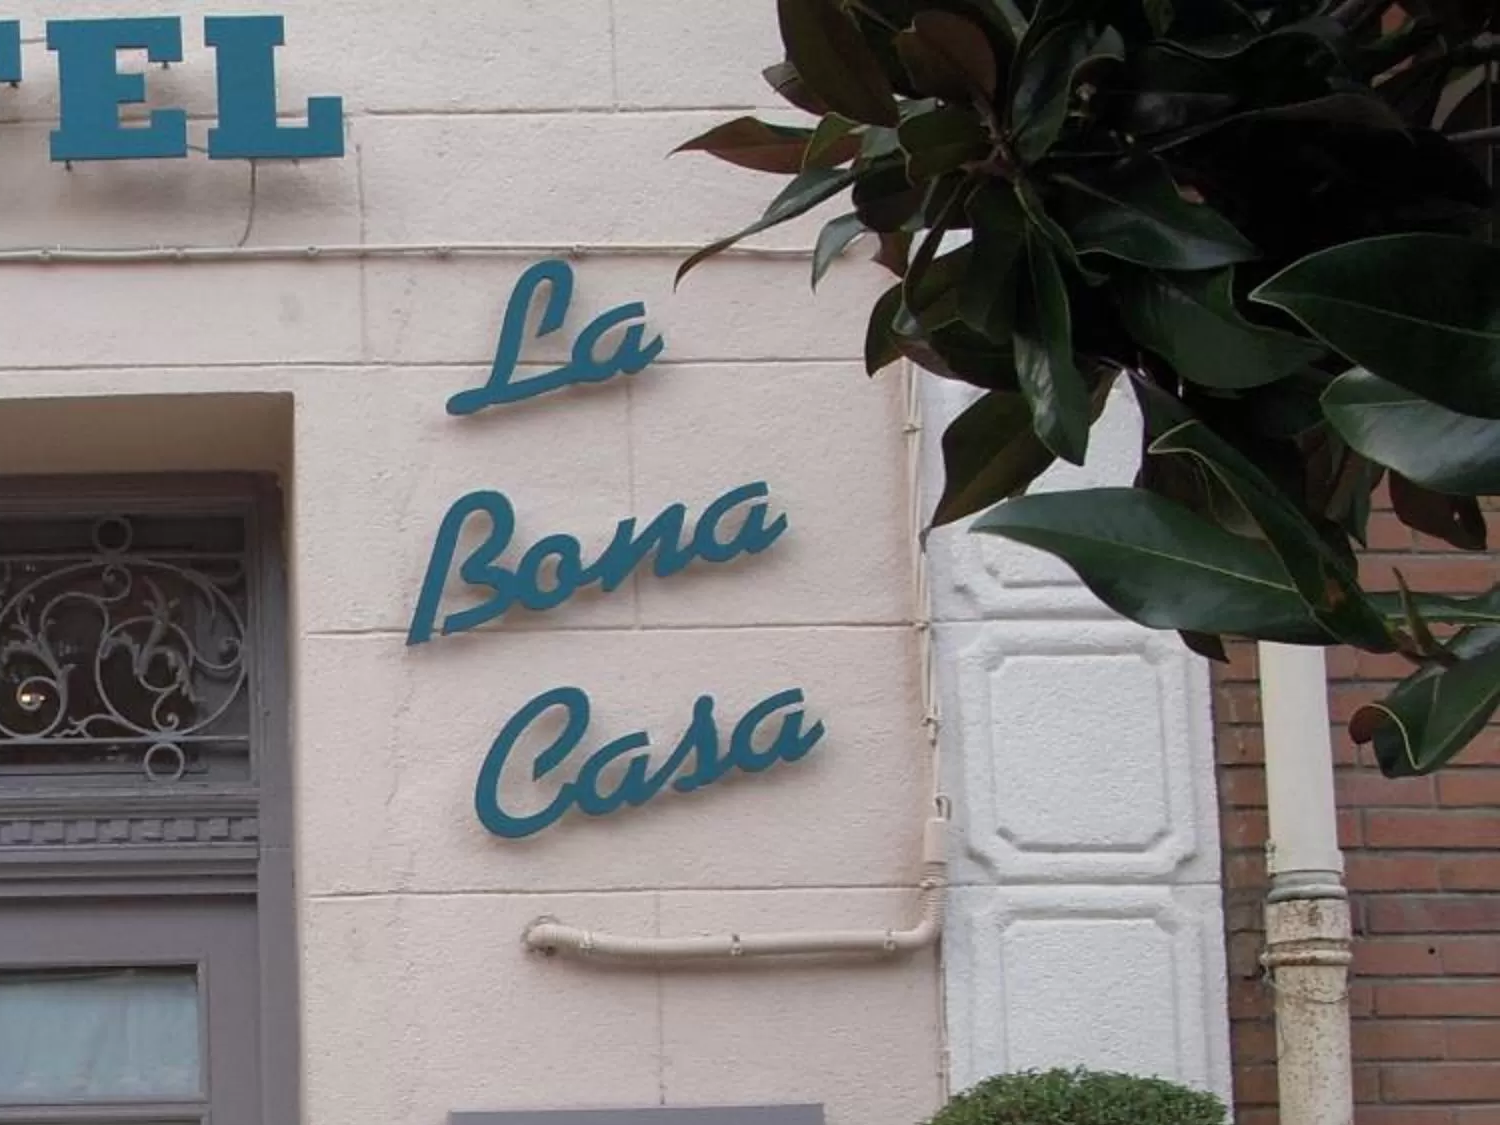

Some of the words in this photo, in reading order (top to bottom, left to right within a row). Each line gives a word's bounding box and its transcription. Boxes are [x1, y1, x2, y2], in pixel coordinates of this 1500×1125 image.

[446, 259, 663, 416] La
[406, 481, 788, 645] Bona
[475, 687, 825, 838] Casa
